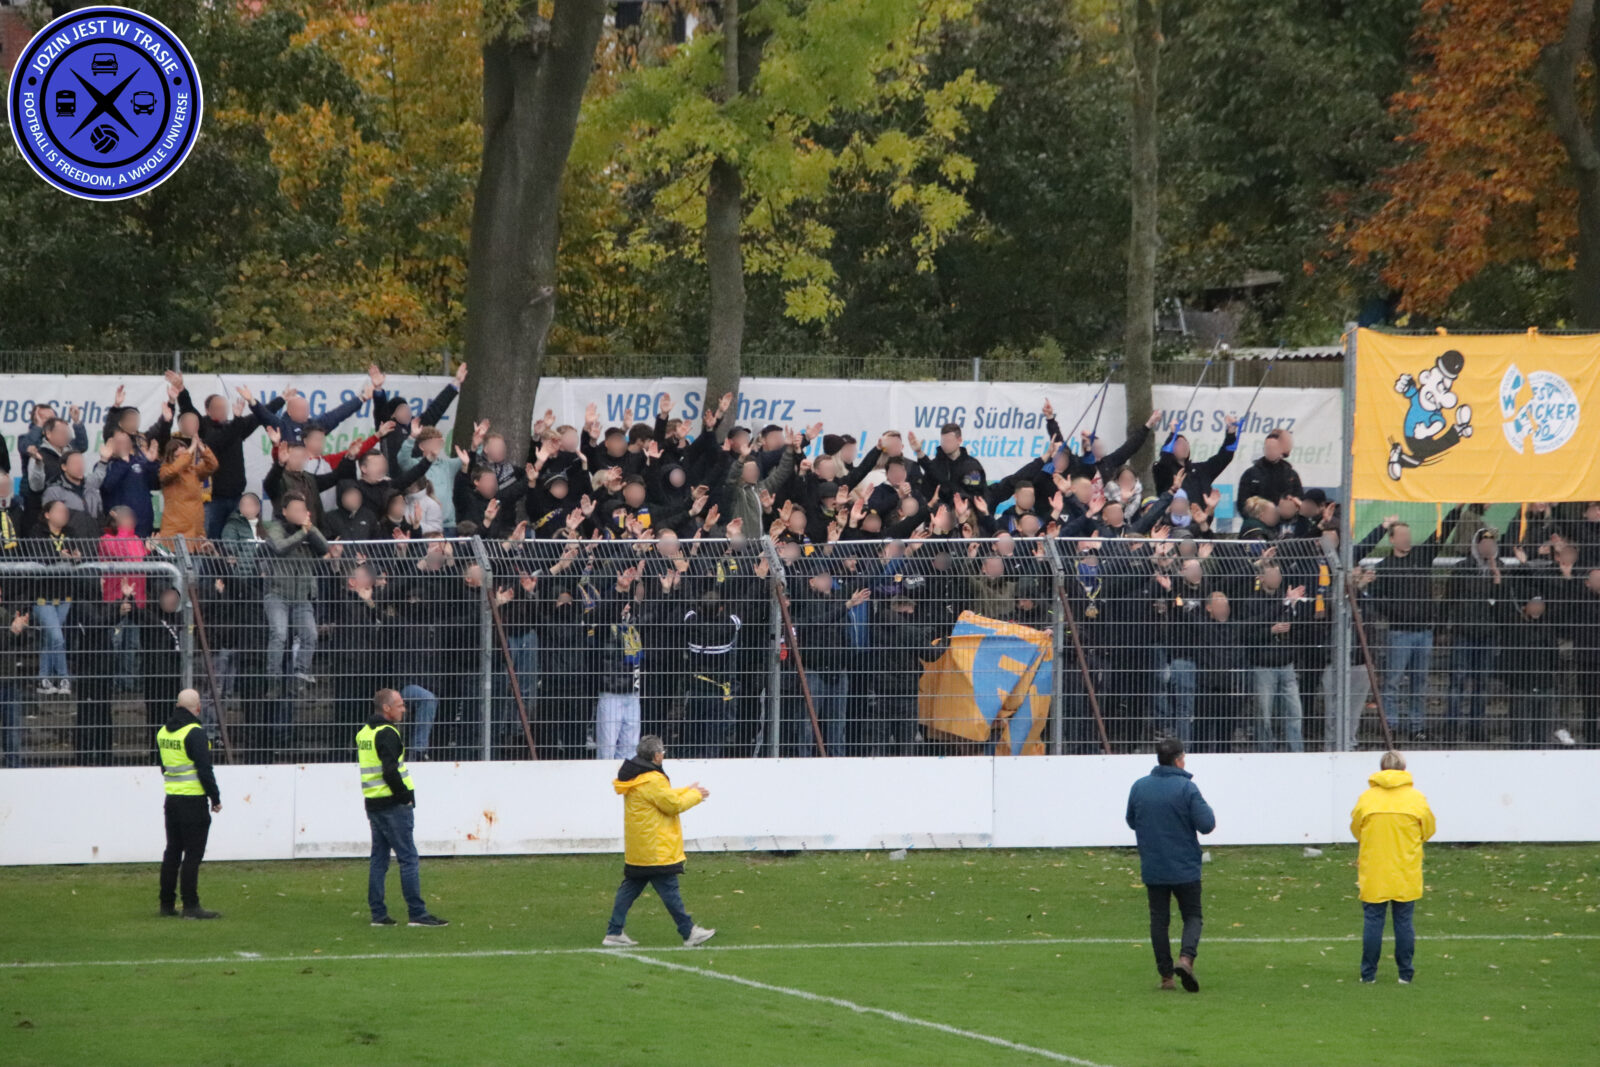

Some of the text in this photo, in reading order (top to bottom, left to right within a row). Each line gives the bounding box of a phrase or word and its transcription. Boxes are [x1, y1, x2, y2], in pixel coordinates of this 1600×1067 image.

[0, 399, 35, 423] BG
[914, 405, 1057, 430] WBG Südhar
[914, 434, 1025, 458] unrstützt
